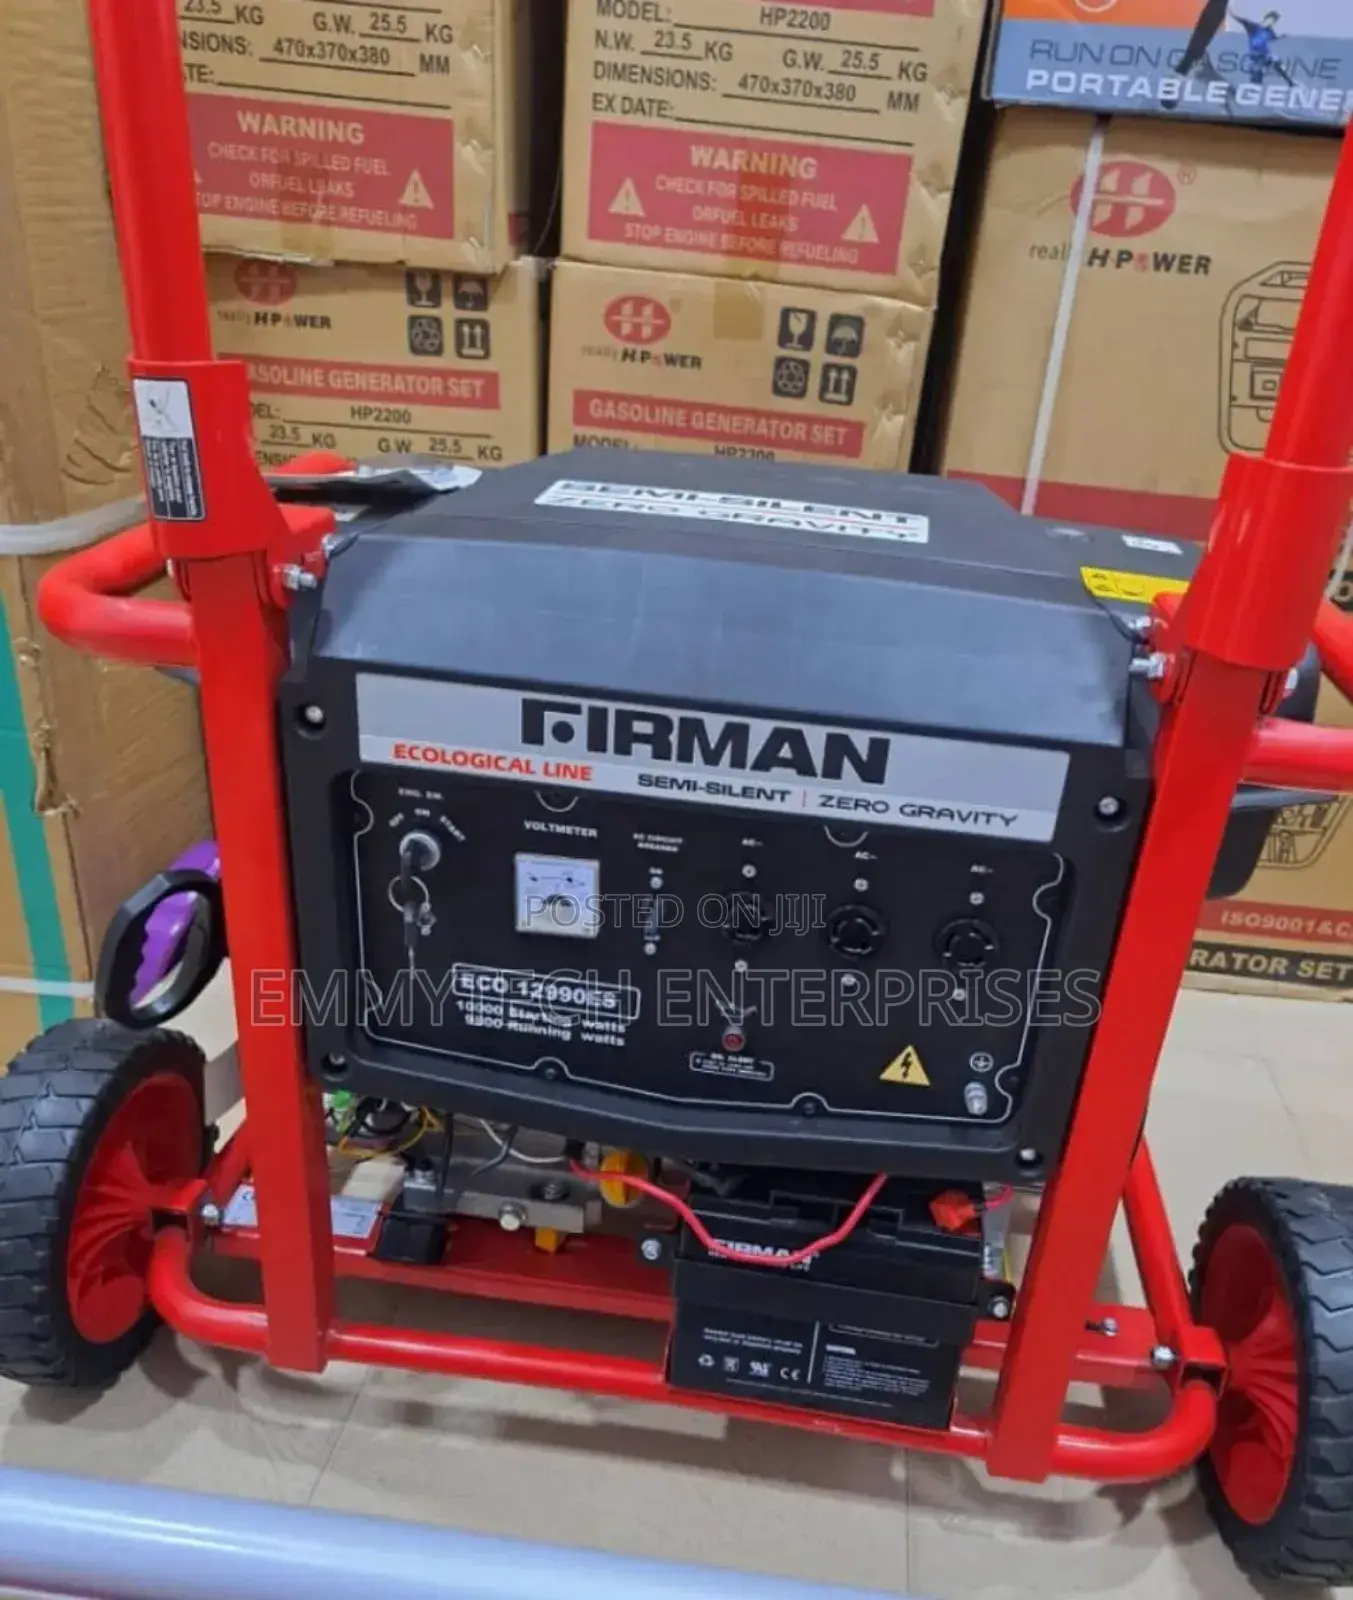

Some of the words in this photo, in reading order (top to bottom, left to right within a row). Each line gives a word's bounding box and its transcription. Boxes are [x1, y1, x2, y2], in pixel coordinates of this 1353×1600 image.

[234, 6, 264, 25] KG
[313, 12, 356, 35] G.W.
[369, 12, 407, 34] 25.5
[426, 22, 453, 44] KG
[597, 0, 671, 22] MODEL:
[760, 7, 830, 31] HP2200
[180, 30, 253, 57] NSIONS:
[273, 38, 390, 66] 470x370x380
[420, 52, 450, 75] MM
[594, 29, 633, 51] N.W.
[654, 29, 692, 50] 23.5
[704, 41, 733, 62] KG
[782, 49, 824, 71] G.W.
[840, 50, 880, 71] 25.5
[898, 61, 928, 82] KG
[1030, 38, 1104, 65] RUN
[1109, 44, 1161, 69] ON
[1166, 49, 1343, 80] GASINE
[593, 60, 717, 91] DIMENSIONS:
[738, 74, 856, 102] 470x370x380
[887, 92, 920, 112] MM
[1026, 69, 1229, 104] PORTABLE
[592, 93, 615, 113] EX
[621, 96, 674, 118] DATE:
[237, 110, 366, 146] WARNING
[207, 142, 255, 163] CHECK
[260, 147, 290, 165] FOR
[294, 149, 350, 172] SPILLED
[354, 156, 392, 177] FUEL
[690, 144, 818, 179] WARNING
[225, 195, 279, 216] ENGINE
[655, 174, 704, 195] CHECK
[707, 180, 736, 199] FOR
[740, 184, 799, 206] SPILLED
[802, 191, 837, 211] FUEL
[624, 222, 661, 240] STOP
[664, 228, 718, 247] ENGINE
[751, 211, 799, 232] LEAKS
[247, 364, 323, 389] ASOLINE
[328, 370, 445, 397] GENERATOR
[447, 377, 485, 399] SET
[350, 406, 412, 425] HP2200
[589, 398, 687, 428] GASOLINE
[691, 409, 807, 443] GENERATOR
[812, 424, 849, 447] SET
[312, 432, 337, 449] KG
[478, 445, 503, 462] KG
[521, 698, 890, 785] FIRMAN
[393, 744, 536, 776] ECOLOGICAL
[543, 760, 593, 782] LINE
[637, 772, 792, 804] SEMI-SILENT
[818, 794, 890, 815] ZERO
[899, 803, 1018, 828] GRAVITY
[524, 819, 598, 838] VOLTMETER
[1220, 909, 1353, 938] ISO9001&C
[1189, 949, 1288, 976] RATOR
[1296, 960, 1353, 981] SET
[460, 973, 508, 993] ECO
[581, 1031, 626, 1047] watts
